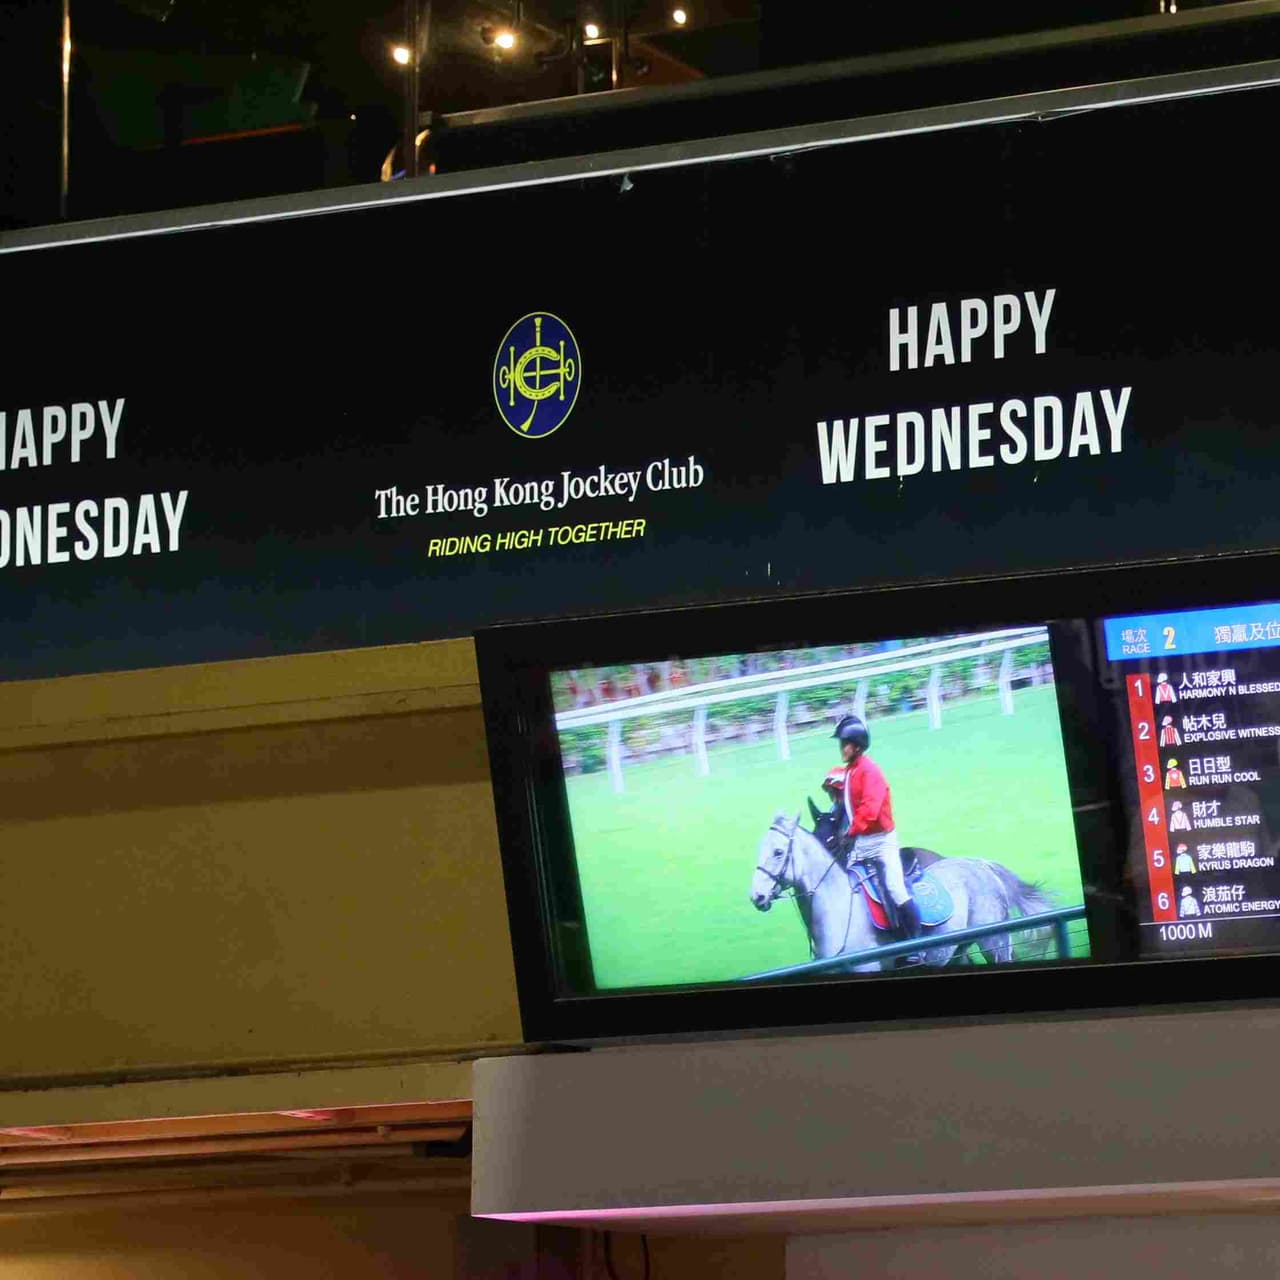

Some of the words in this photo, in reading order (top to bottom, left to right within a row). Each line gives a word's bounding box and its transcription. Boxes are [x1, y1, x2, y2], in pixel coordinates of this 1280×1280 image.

[889, 289, 1056, 371] HAPPY
[0, 398, 125, 470] APPY
[817, 386, 1132, 484] WEDNESDAY
[375, 486, 419, 518] The
[425, 484, 488, 517] Hong
[493, 478, 555, 510] Kong
[557, 465, 642, 506] Jockey
[646, 455, 704, 491] Club
[0, 490, 188, 568] NESDAY
[428, 534, 491, 557] RIDING
[496, 529, 543, 551] HIGH
[548, 519, 646, 545] TOGETHER
[1163, 627, 1176, 649] 2
[1123, 643, 1151, 654] RACE
[1179, 669, 1236, 689] 人和家興
[1179, 686, 1227, 700] HARMONY
[1228, 686, 1236, 695] N
[1184, 729, 1237, 743] EXPLOSIVE
[1189, 756, 1231, 775] 日日型
[1189, 775, 1210, 786] RUN
[1213, 773, 1232, 784] RUN
[1233, 771, 1261, 782] COOL
[1203, 902, 1240, 914] ATOMIC
[1241, 900, 1280, 911] ENERGY
[1160, 924, 1196, 941] 1000
[1198, 922, 1212, 938] M
